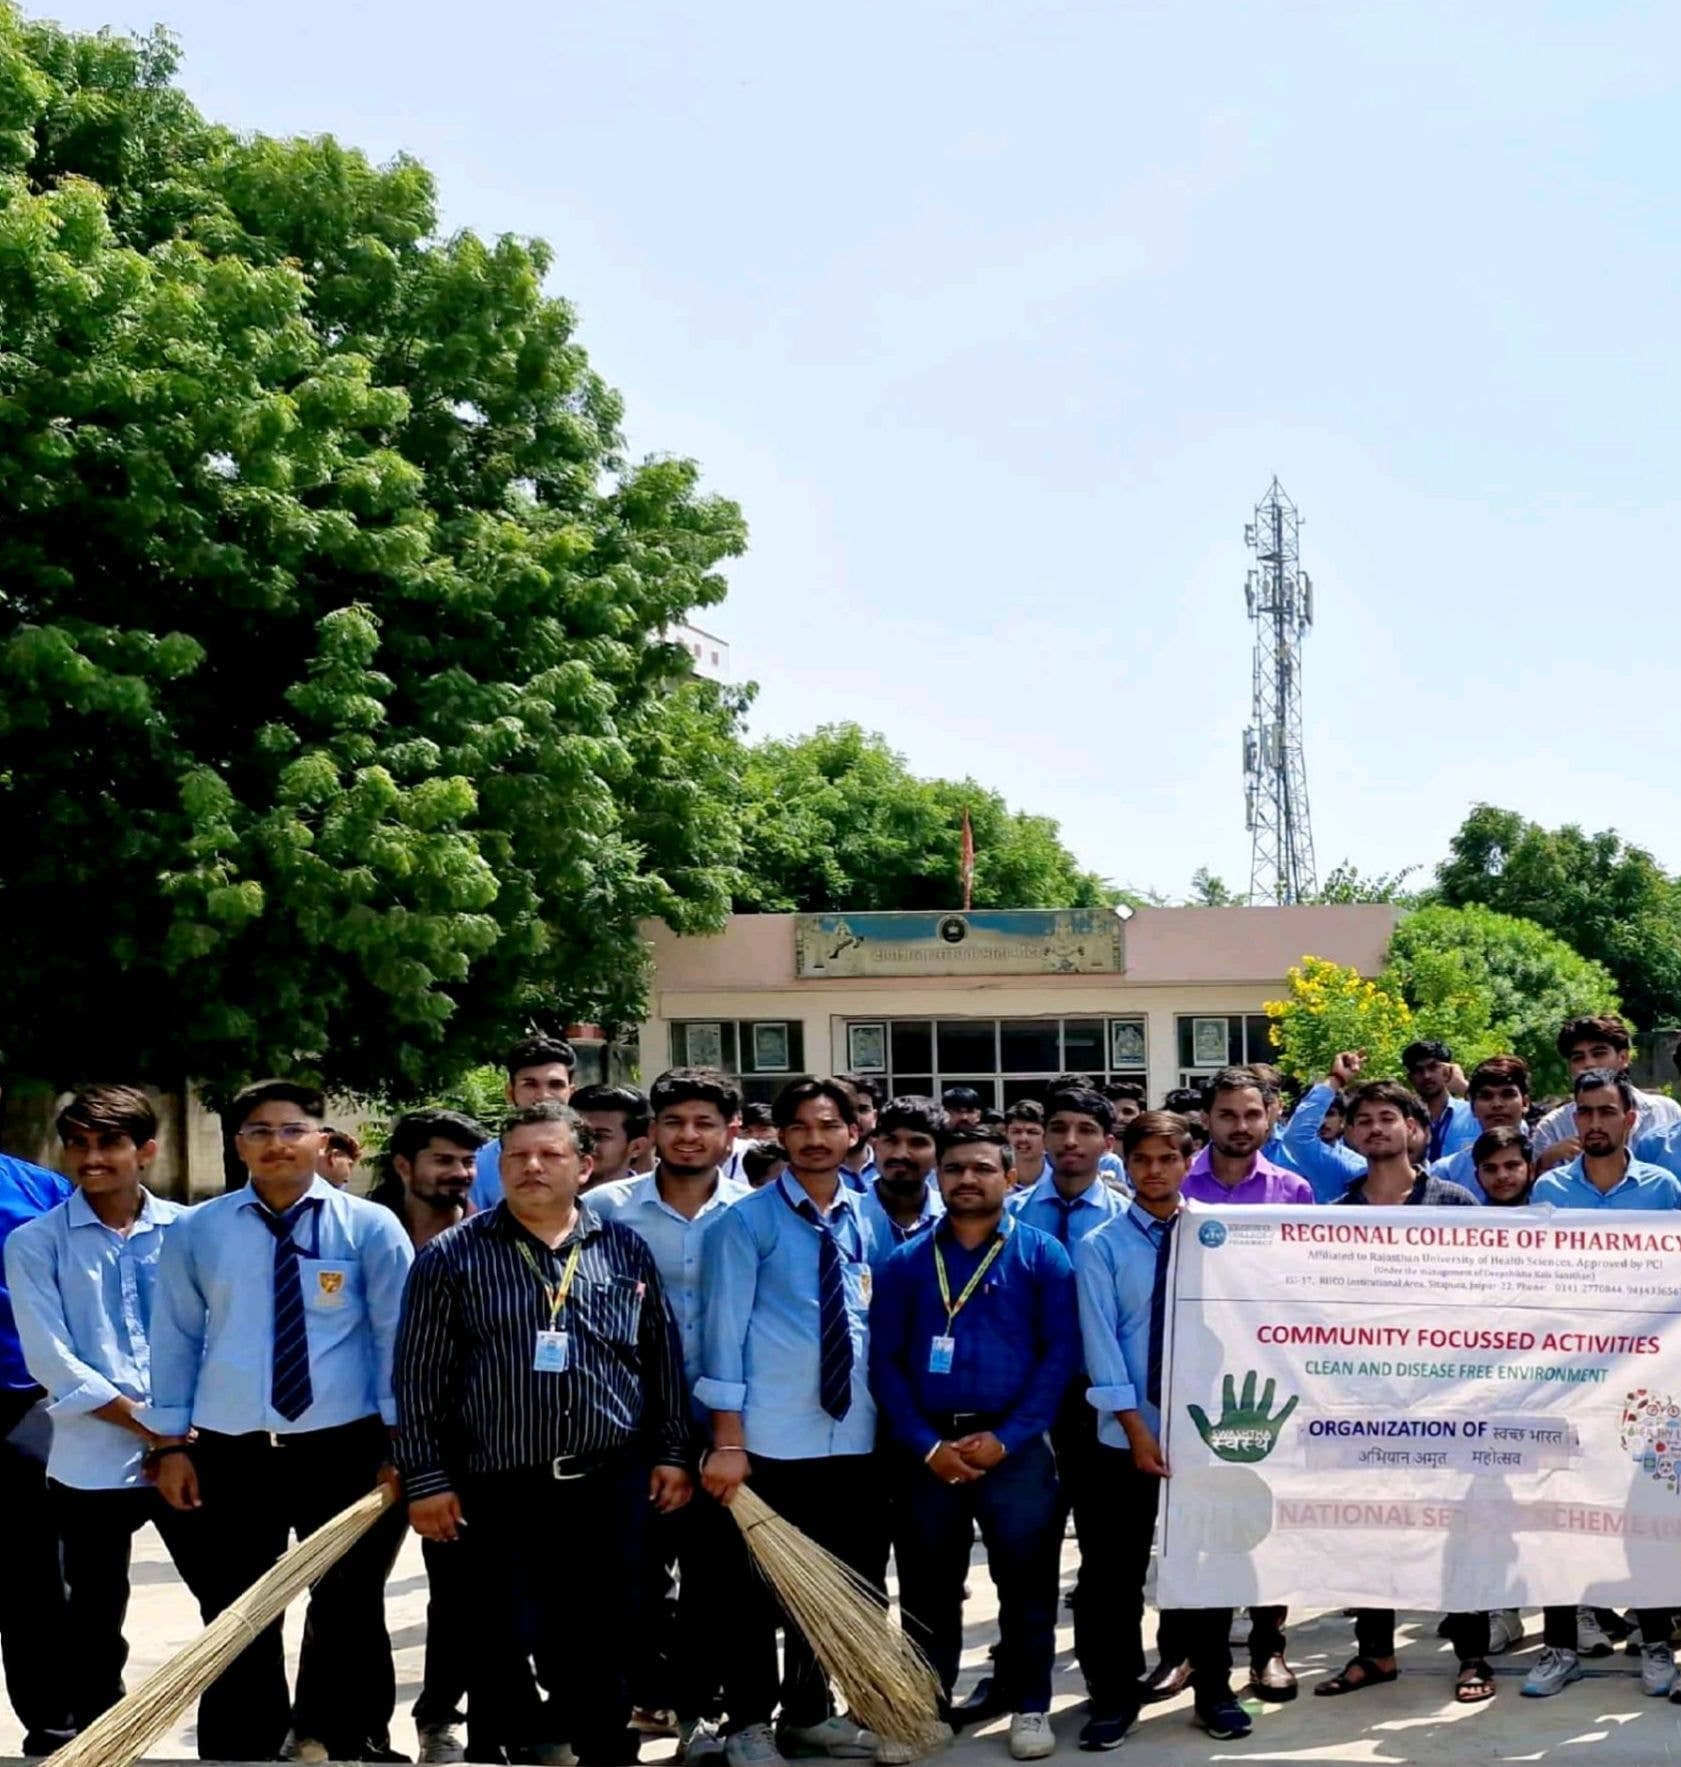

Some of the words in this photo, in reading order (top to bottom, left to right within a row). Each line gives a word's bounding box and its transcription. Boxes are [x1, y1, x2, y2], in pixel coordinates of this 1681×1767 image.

[1281, 1223, 1399, 1245] REGIONAL
[1405, 1226, 1510, 1248] COLLEGE
[1516, 1229, 1548, 1249] OF
[1307, 1250, 1354, 1262] Affiliated
[1356, 1252, 1368, 1262] to
[1369, 1252, 1420, 1266] Rajasthan
[1422, 1253, 1475, 1267] University
[1477, 1254, 1488, 1265] of
[1490, 1255, 1525, 1267] Health
[1576, 1257, 1628, 1272] Approved
[1630, 1258, 1644, 1272] by
[1646, 1259, 1664, 1270] PCI
[1257, 1325, 1411, 1347] COMMUNITY
[1417, 1329, 1535, 1350] FOCUSSED
[1541, 1333, 1660, 1354] ACTIVITIES
[1304, 1361, 1354, 1376] CLEAN
[1358, 1362, 1392, 1377] AND
[1396, 1363, 1455, 1379] DISEASE
[1459, 1364, 1493, 1379] FREE
[1499, 1366, 1609, 1384] ENVIRONMENT
[1309, 1420, 1456, 1438] ORGANIZATION
[1462, 1421, 1488, 1438] OF
[1493, 1426, 1525, 1444] स्वच्छ
[1530, 1427, 1562, 1445] भारत
[1358, 1447, 1410, 1465] अभियान
[1414, 1451, 1447, 1469] अमृत
[1472, 1446, 1523, 1466] महोत्सव
[1279, 1503, 1416, 1527] NATIONAL
[1537, 1507, 1647, 1534] CHEME
